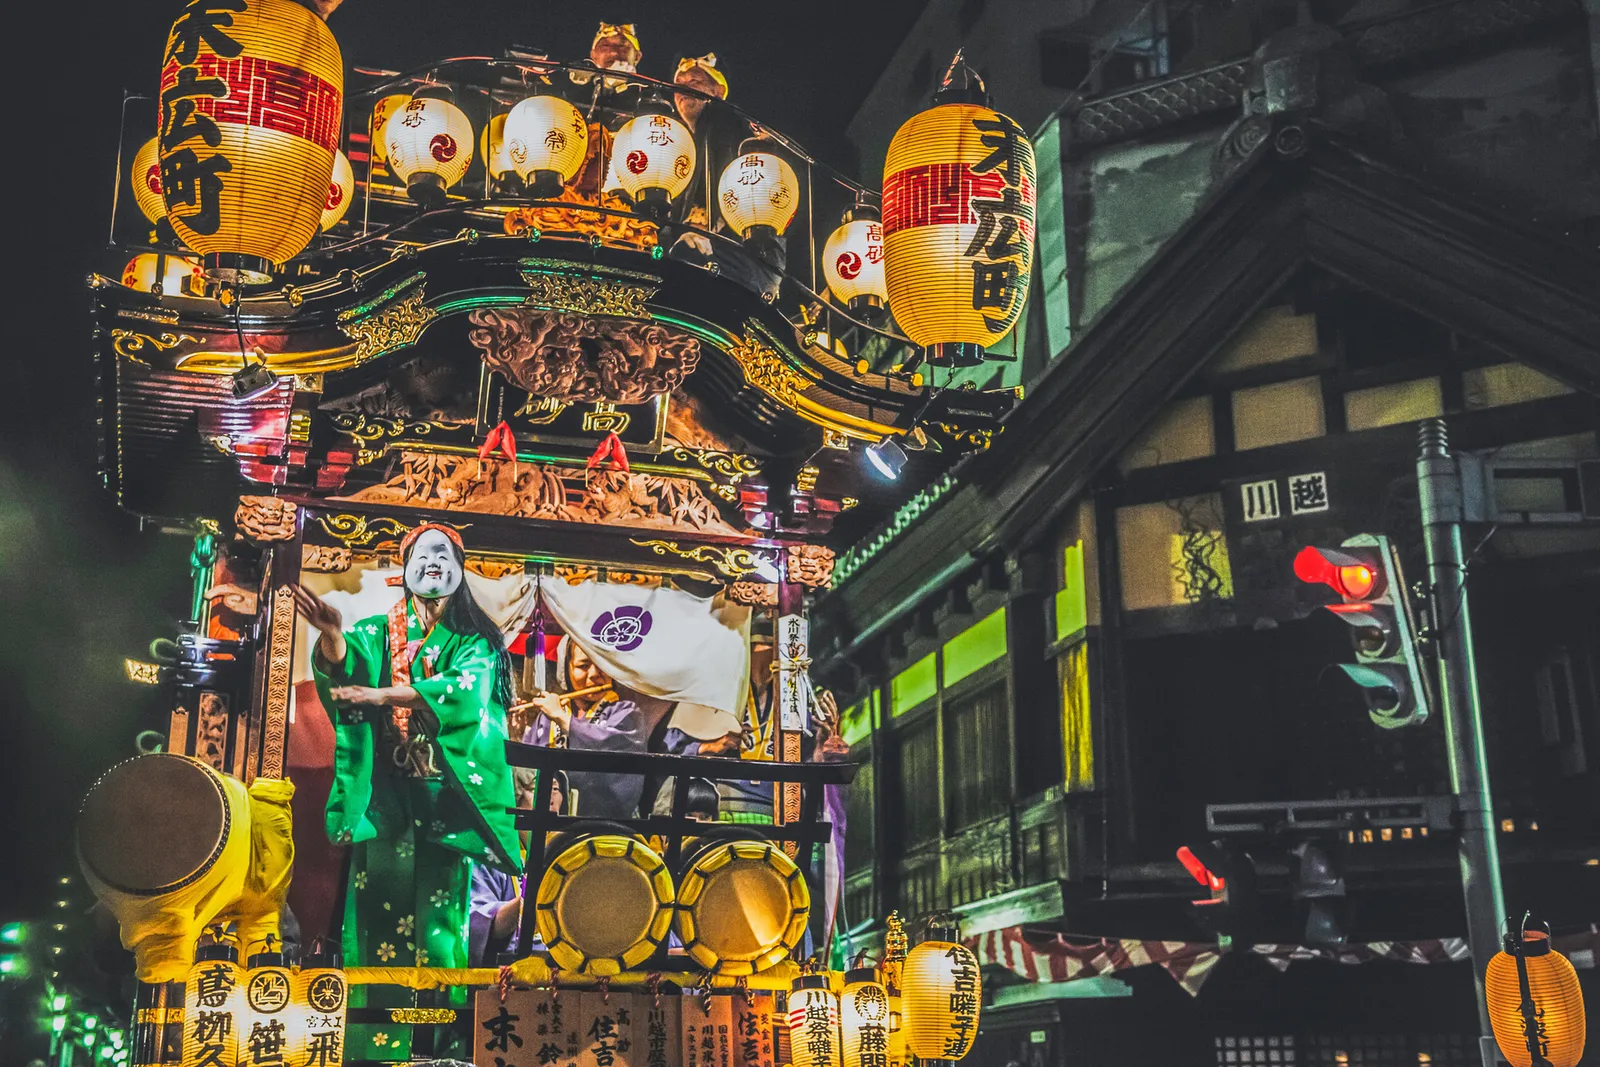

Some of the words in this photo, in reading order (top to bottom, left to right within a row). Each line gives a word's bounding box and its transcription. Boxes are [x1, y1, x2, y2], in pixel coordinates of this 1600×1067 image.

[162, 0, 248, 235] 末広町
[402, 99, 426, 128] 高砂
[647, 116, 674, 147] 高砂
[737, 155, 765, 185] 高砂
[1246, 475, 1325, 519] 川越
[942, 946, 977, 1057] 住吉囃子連
[688, 1025, 697, 1067] ユネスコ
[701, 1025, 717, 1067] 川越氷
